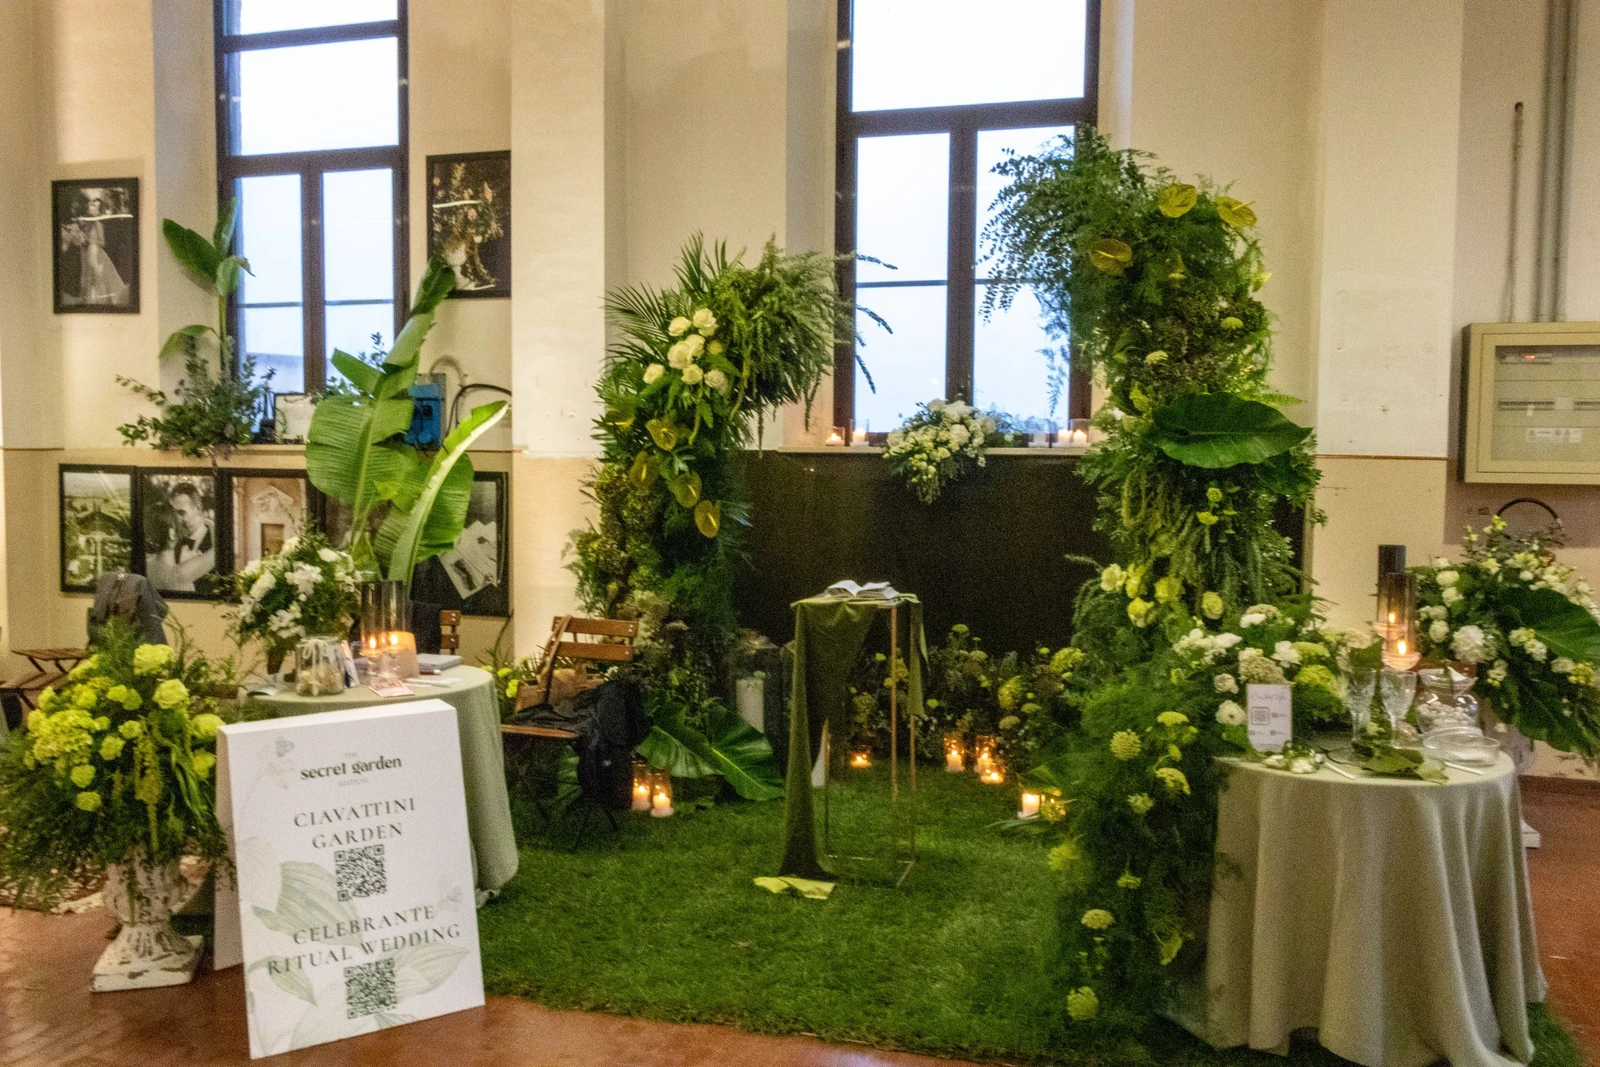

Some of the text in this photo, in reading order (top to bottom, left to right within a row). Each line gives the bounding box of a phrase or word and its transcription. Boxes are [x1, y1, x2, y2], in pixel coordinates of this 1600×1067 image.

[300, 755, 402, 780] secret garden
[294, 797, 414, 828] CIAVATTINI
[312, 822, 402, 849] GARDEN
[293, 905, 435, 945] CELEBRANTE
[267, 924, 460, 976] RITUAL WEDDING
